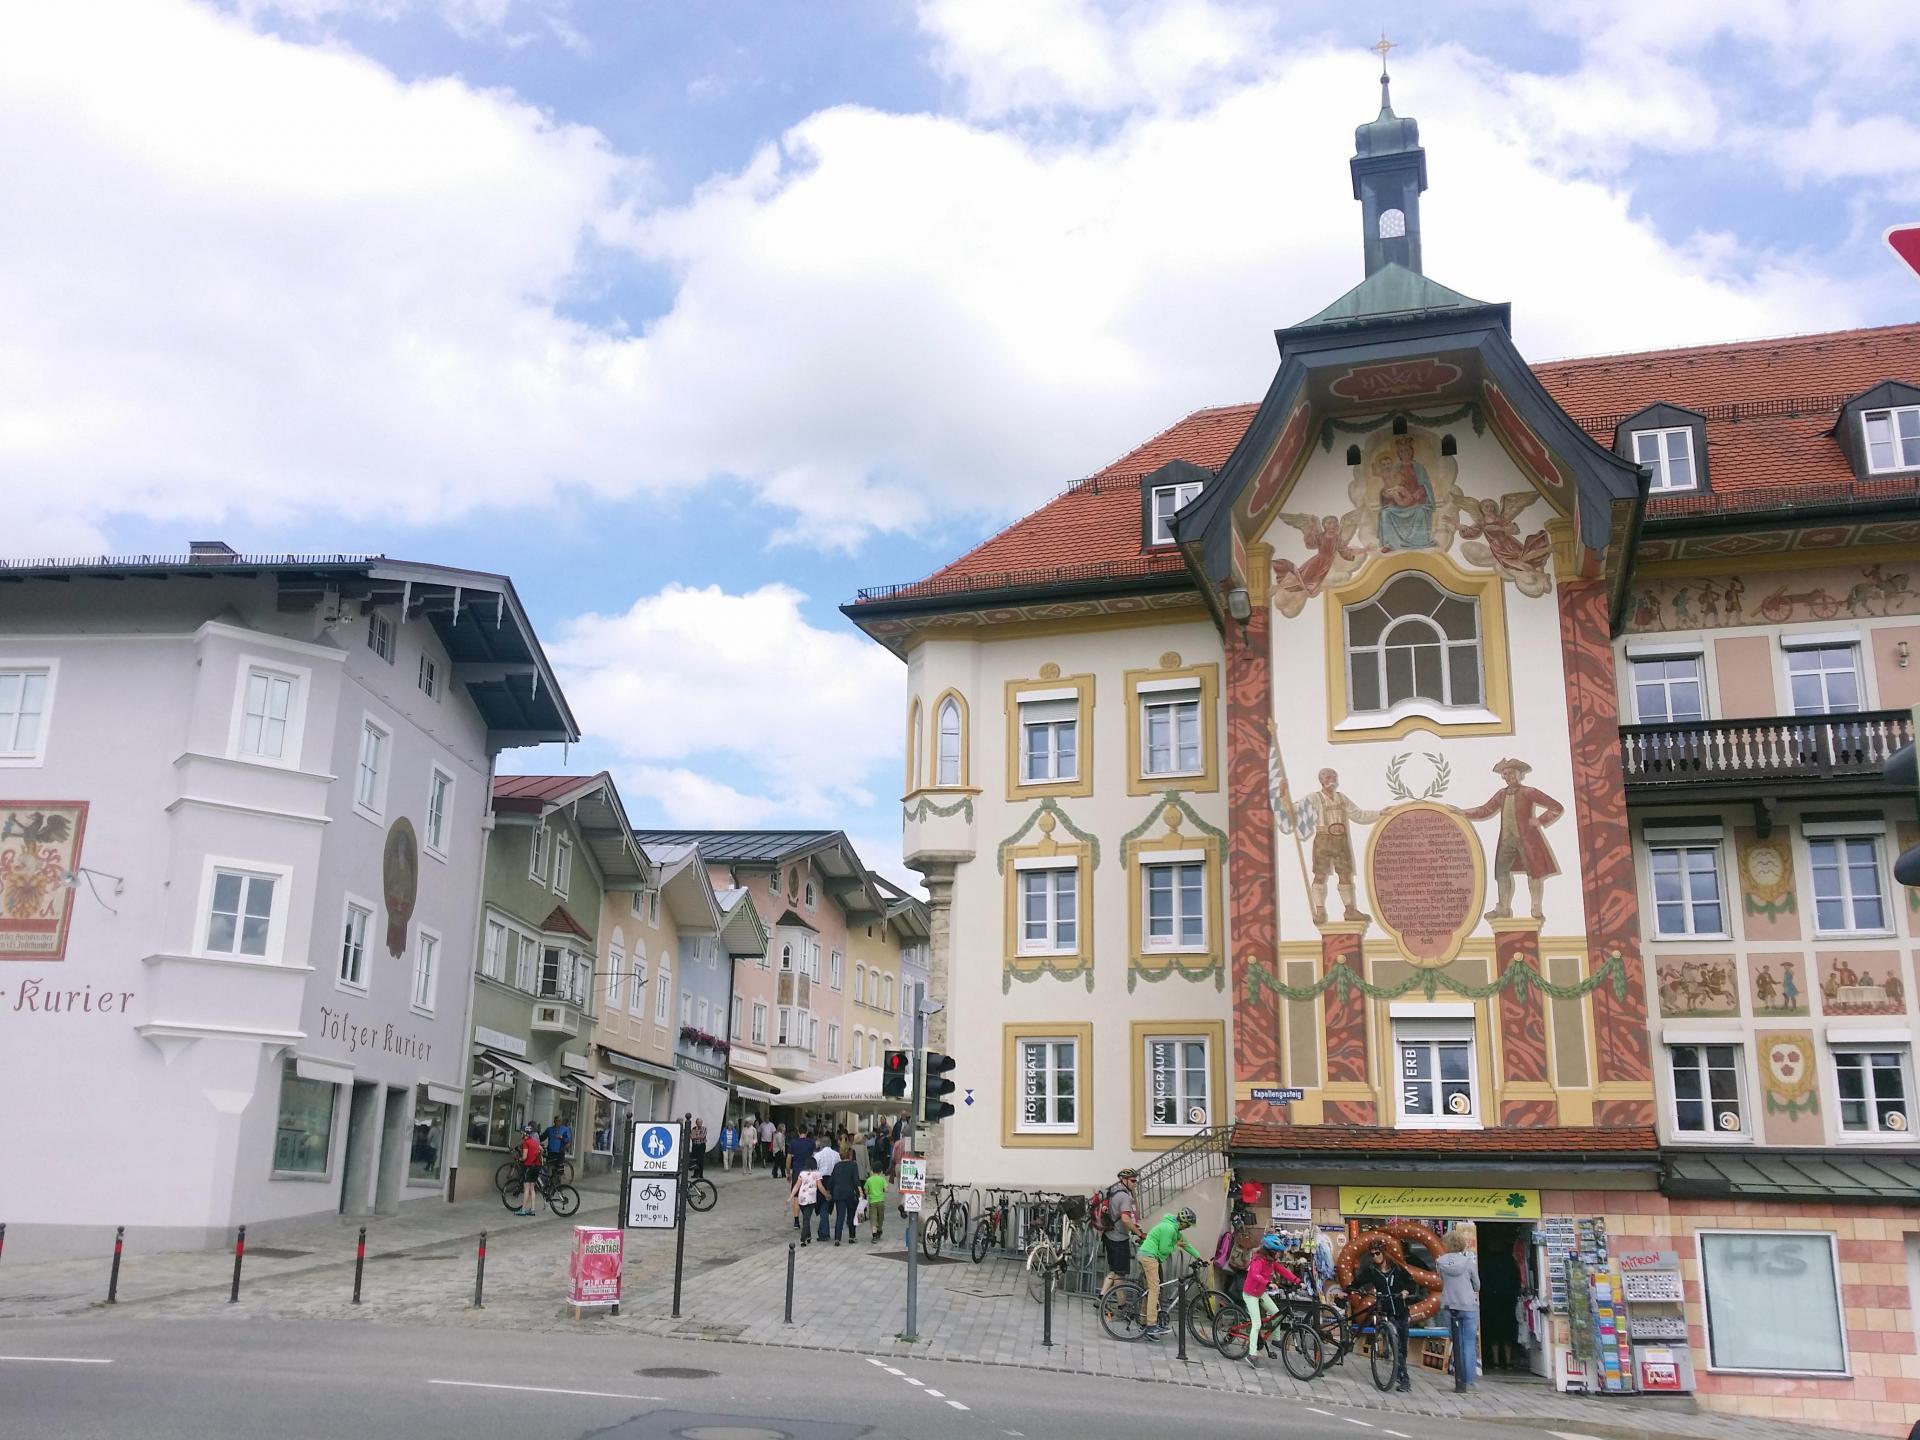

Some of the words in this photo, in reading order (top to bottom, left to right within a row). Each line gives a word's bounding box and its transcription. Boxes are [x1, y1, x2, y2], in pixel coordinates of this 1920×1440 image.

[13, 977, 135, 1014] Kurier
[320, 1006, 378, 1053] Tölzer
[383, 1023, 432, 1062] Kurier
[1025, 1047, 1036, 1123] HÖRGERÄTE
[1154, 1043, 1165, 1124] KLANGRAUM
[1253, 1090, 1302, 1100] Kapellengasteig
[643, 1160, 668, 1170] ZONE
[646, 1203, 659, 1211] frei
[1354, 1188, 1503, 1213] Glücksmomente
